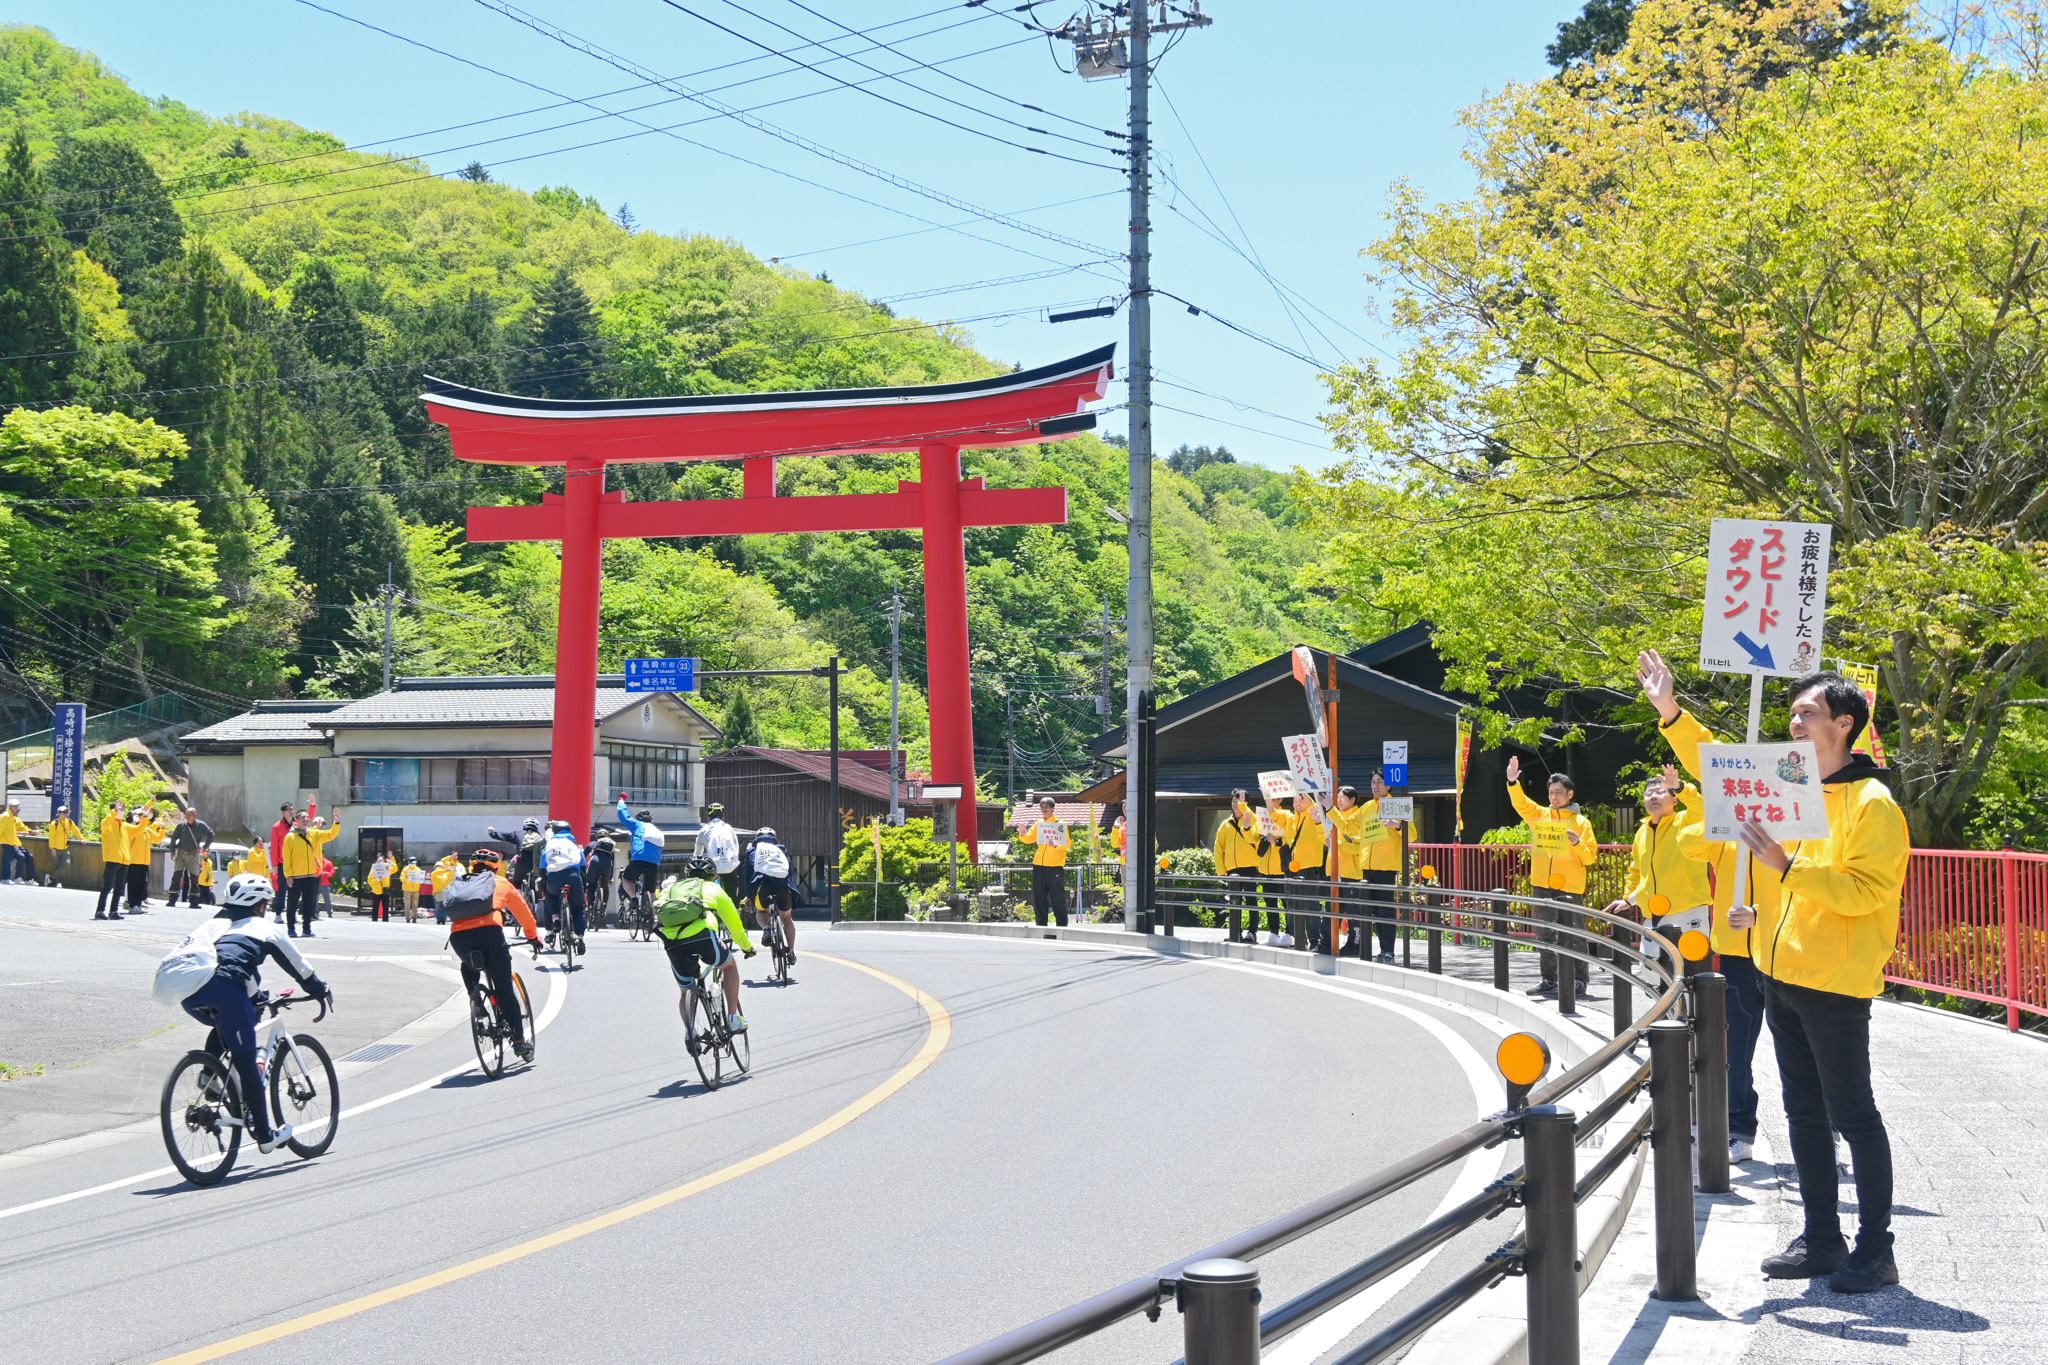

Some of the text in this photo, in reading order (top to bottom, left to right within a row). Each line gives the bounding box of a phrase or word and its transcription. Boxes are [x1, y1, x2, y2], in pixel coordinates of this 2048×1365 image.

[1723, 538, 1755, 618] ダウン
[1759, 528, 1786, 634] スピード
[1796, 529, 1821, 638] お疲れ様でした
[643, 677, 676, 685] 榛名神社
[1291, 743, 1304, 774] ダウン
[1299, 738, 1315, 777] スピード
[1390, 767, 1401, 782] 10
